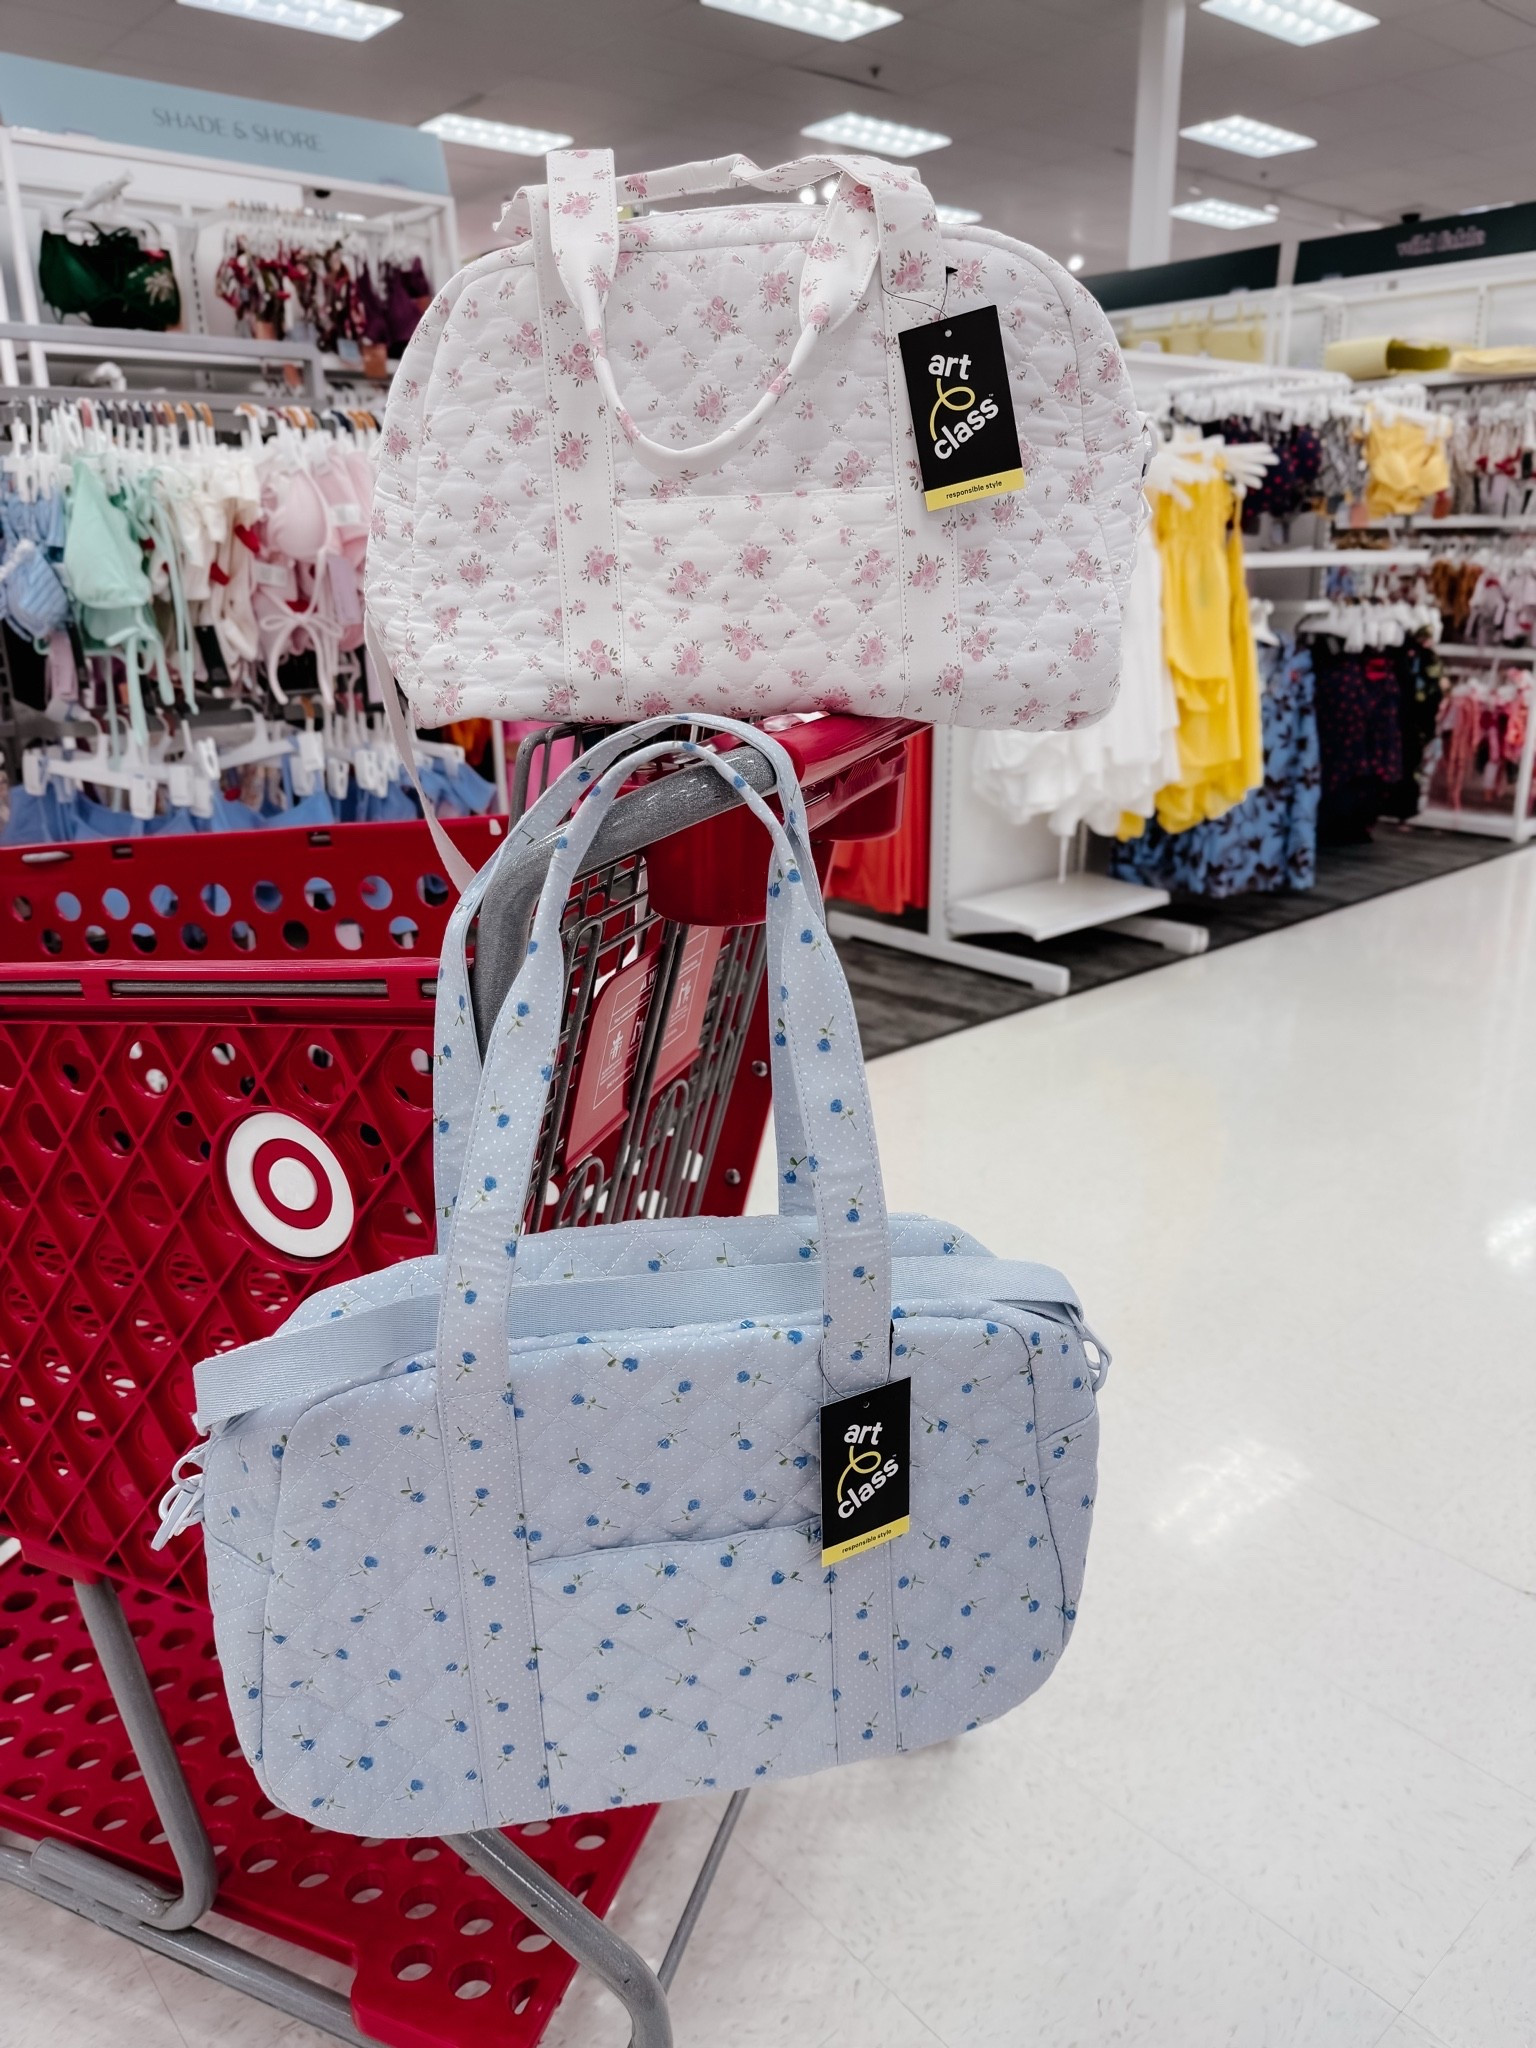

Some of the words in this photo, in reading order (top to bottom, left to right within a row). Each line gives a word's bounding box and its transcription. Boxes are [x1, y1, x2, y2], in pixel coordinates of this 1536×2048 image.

[152, 107, 227, 137] SHADE
[233, 121, 249, 140] &
[252, 123, 325, 152] SHORE
[928, 354, 972, 381] art
[934, 398, 999, 460] class
[945, 483, 985, 500] responsible
[985, 480, 1003, 492] style
[843, 1422, 883, 1446] art
[837, 1458, 899, 1519] class
[842, 1534, 877, 1554] responsible
[877, 1528, 892, 1541] style
